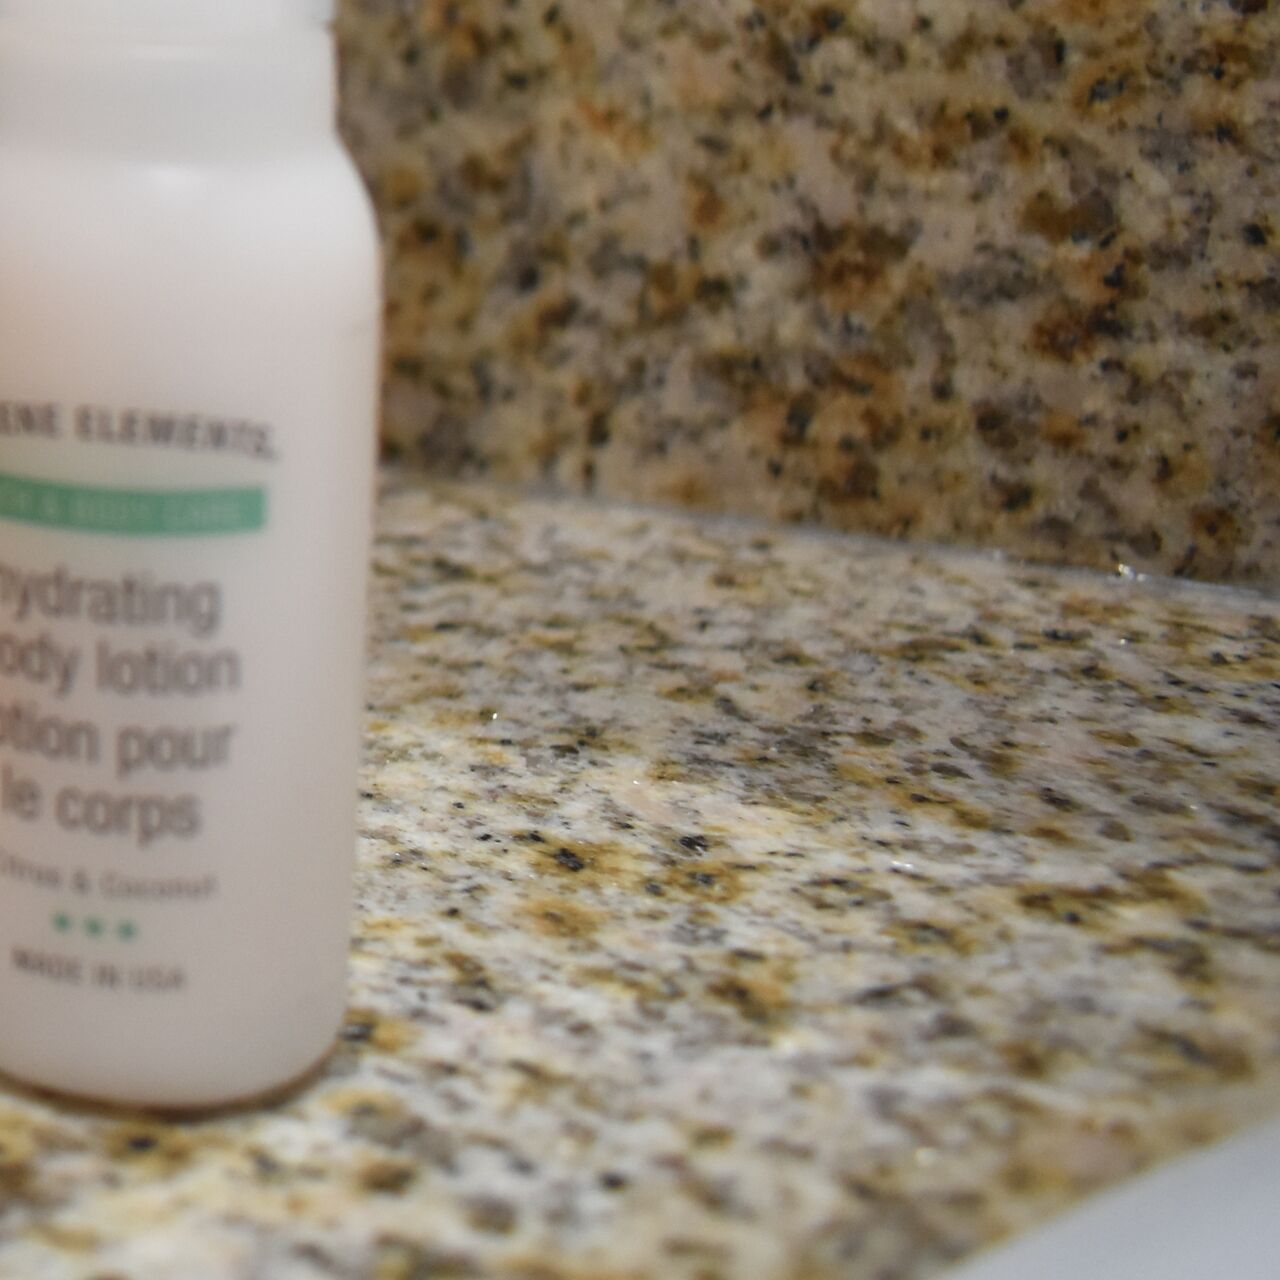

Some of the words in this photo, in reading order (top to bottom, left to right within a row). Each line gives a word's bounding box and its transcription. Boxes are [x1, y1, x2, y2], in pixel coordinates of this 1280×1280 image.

[95, 641, 243, 693] lotion
[116, 721, 234, 778] pour
[1, 765, 44, 818] le
[53, 785, 203, 846] corps
